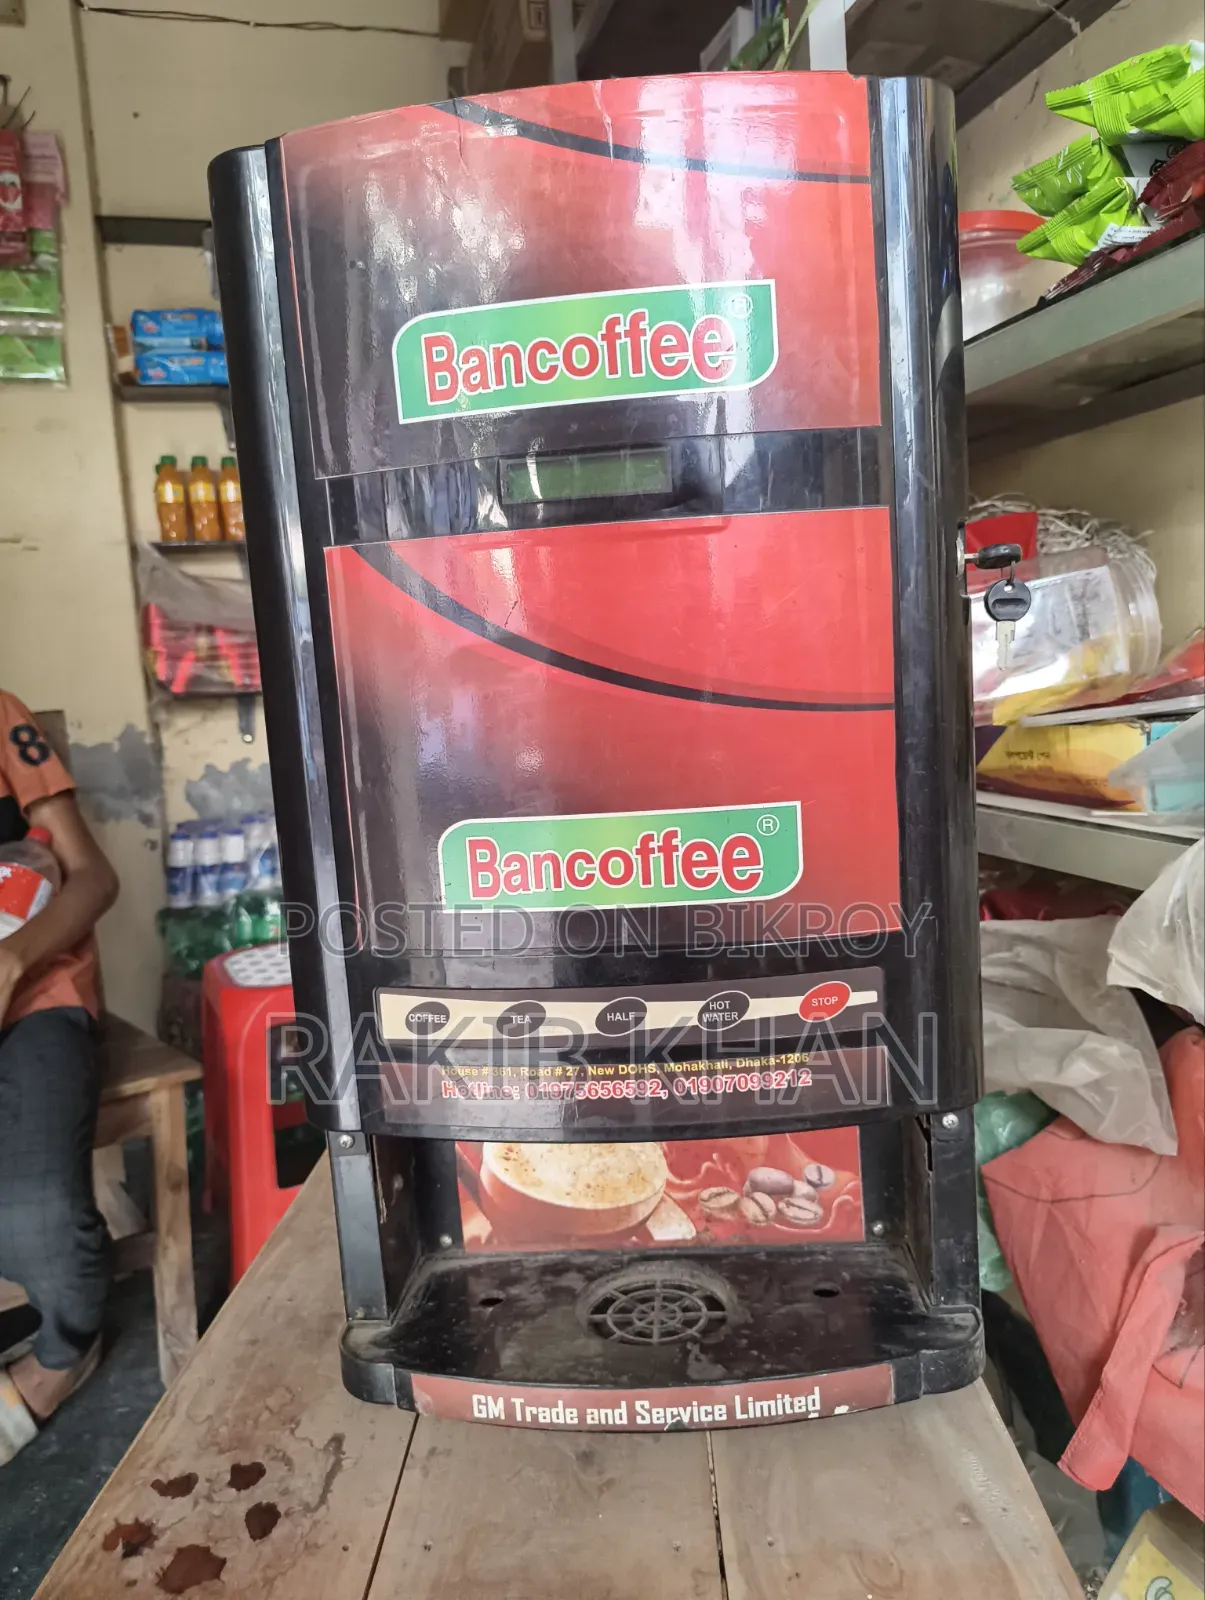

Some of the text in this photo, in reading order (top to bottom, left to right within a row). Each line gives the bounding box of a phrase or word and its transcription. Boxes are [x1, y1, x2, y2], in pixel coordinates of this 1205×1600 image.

[421, 309, 737, 406] Bancoffee
[9, 724, 50, 766] 8
[466, 828, 763, 900] Bancoffee
[709, 1000, 731, 1011] HOT
[811, 996, 839, 1007] STOP
[408, 1013, 447, 1024] COFFEE
[510, 1014, 532, 1024] TEA
[606, 1012, 635, 1022] HALF
[702, 1011, 739, 1023] WATER
[441, 1065, 478, 1077] House
[520, 1066, 552, 1077] Road
[588, 1065, 615, 1076] New
[618, 1063, 661, 1075] DOHS,
[664, 1057, 733, 1073] Mohakhali,
[736, 1053, 810, 1069] Dhaka-1206
[441, 1068, 812, 1100] Hotline: 01975656592, 01907099212
[472, 1386, 821, 1425] GM Trade and Service Limited
